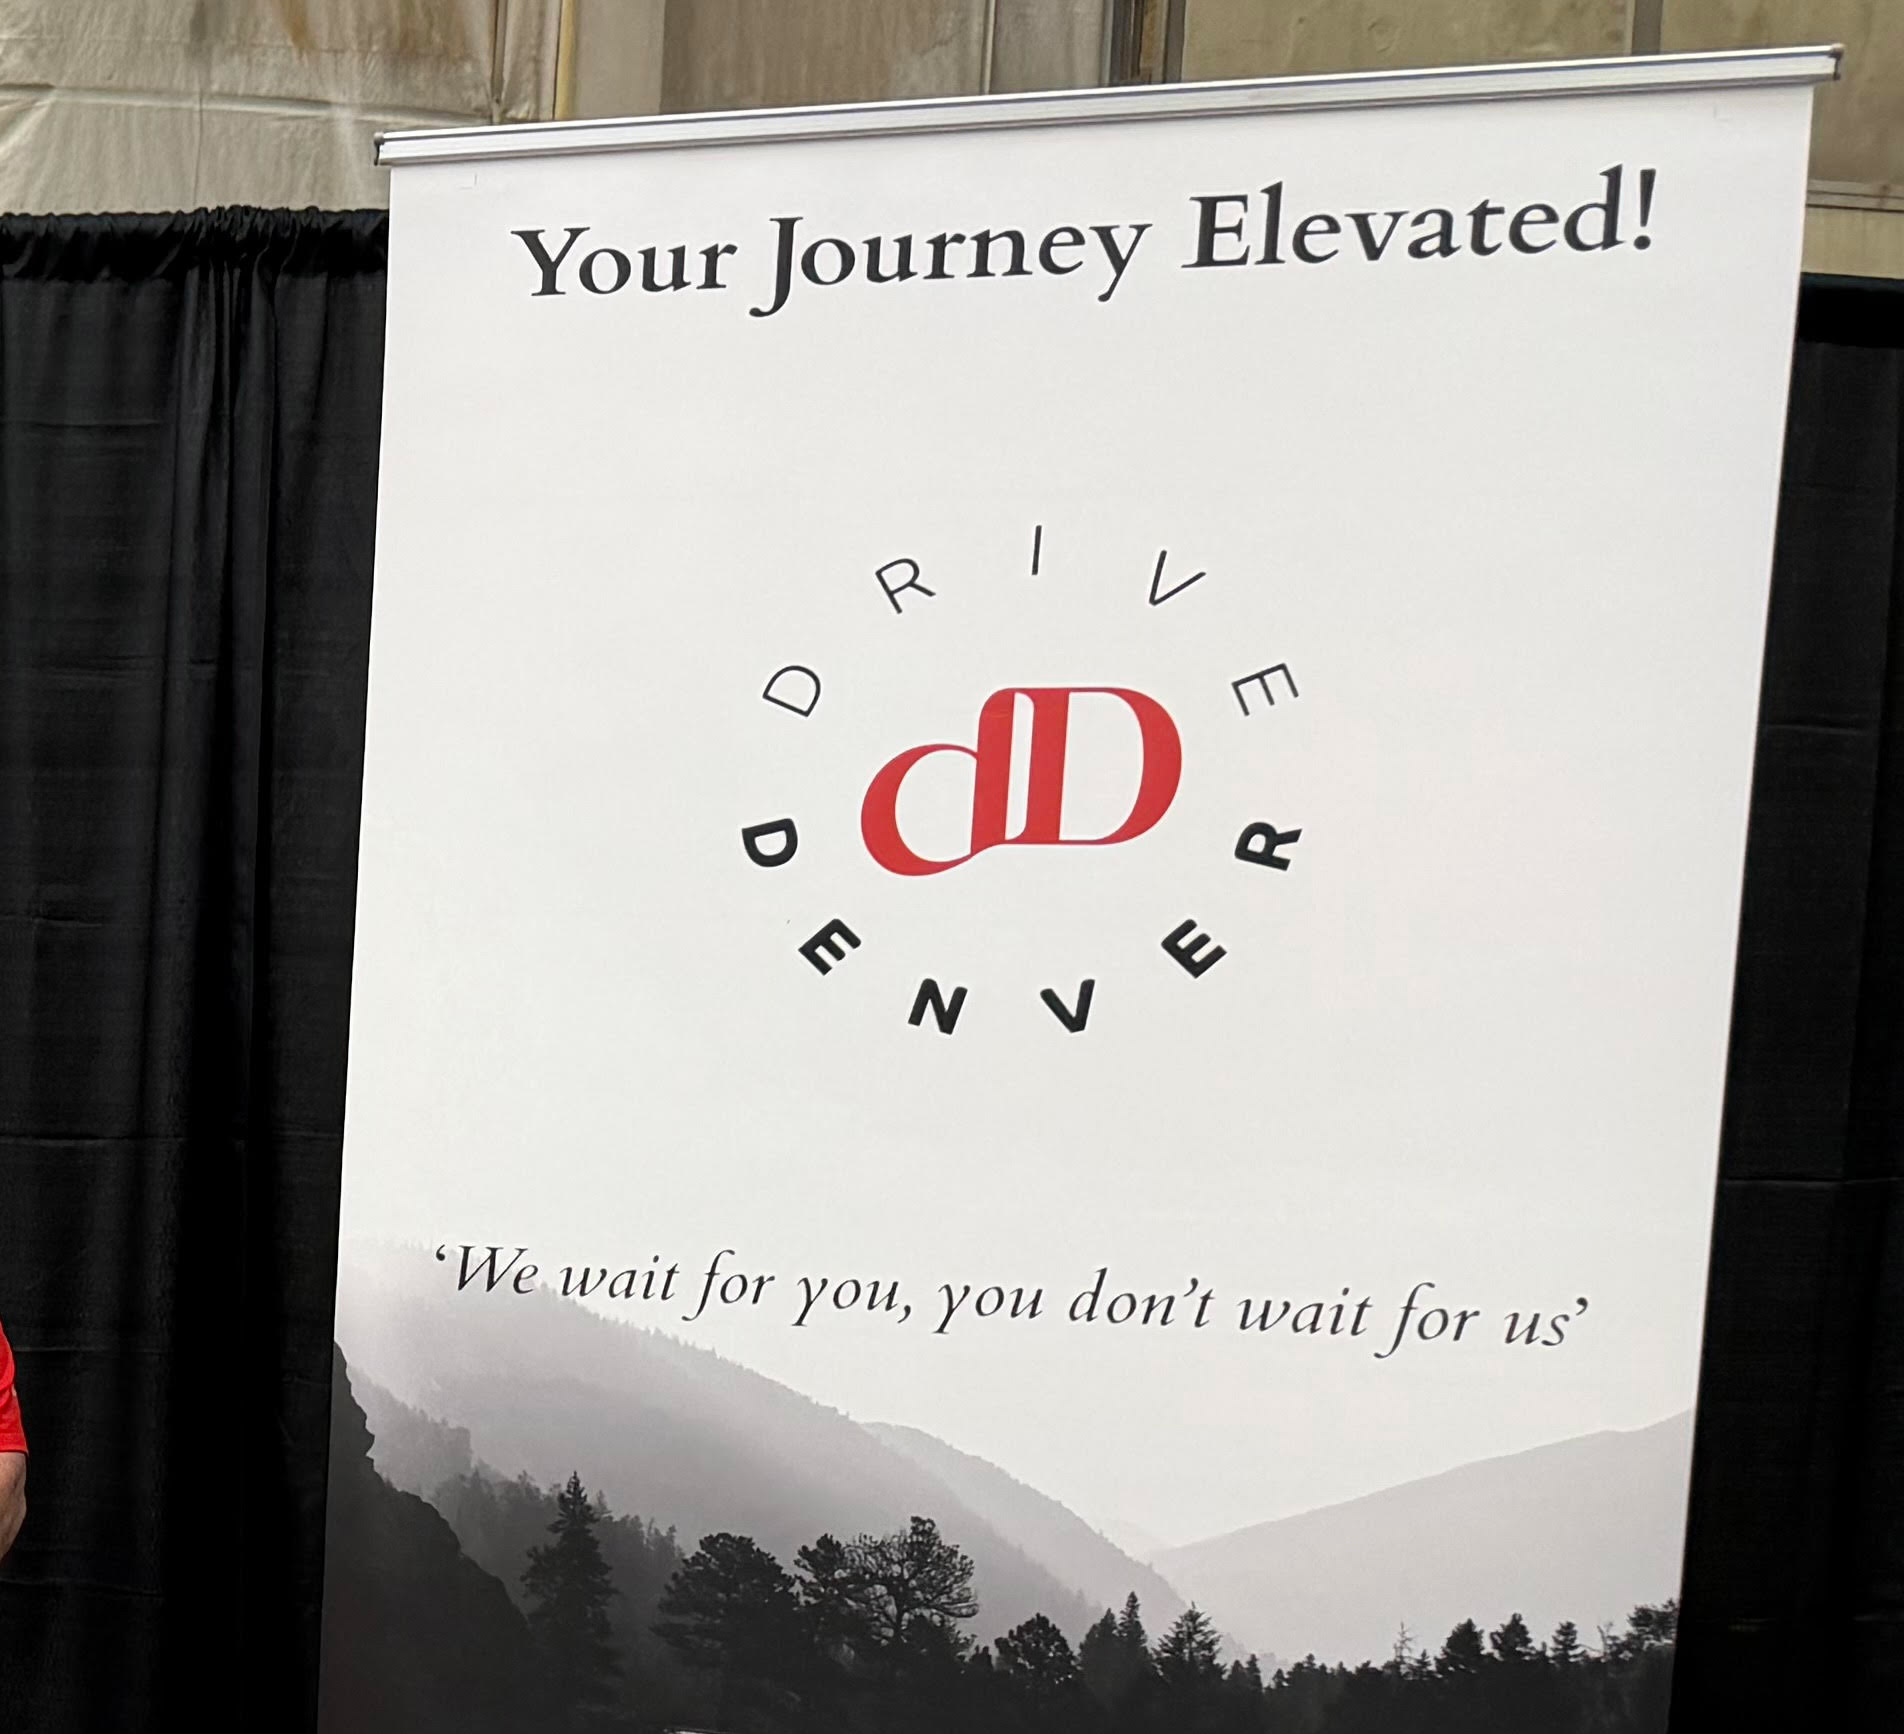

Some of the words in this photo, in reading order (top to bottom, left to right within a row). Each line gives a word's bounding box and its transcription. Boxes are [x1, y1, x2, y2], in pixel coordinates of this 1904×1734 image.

[511, 227, 737, 296] Your
[750, 217, 1152, 317] Journey
[1182, 165, 1655, 268] Elevated!
[562, 1256, 679, 1300] wait
[682, 1250, 774, 1320] for
[794, 1278, 910, 1326] you,
[935, 1285, 1042, 1333] you
[1240, 1288, 1371, 1335] wait
[1374, 1282, 1479, 1358] for
